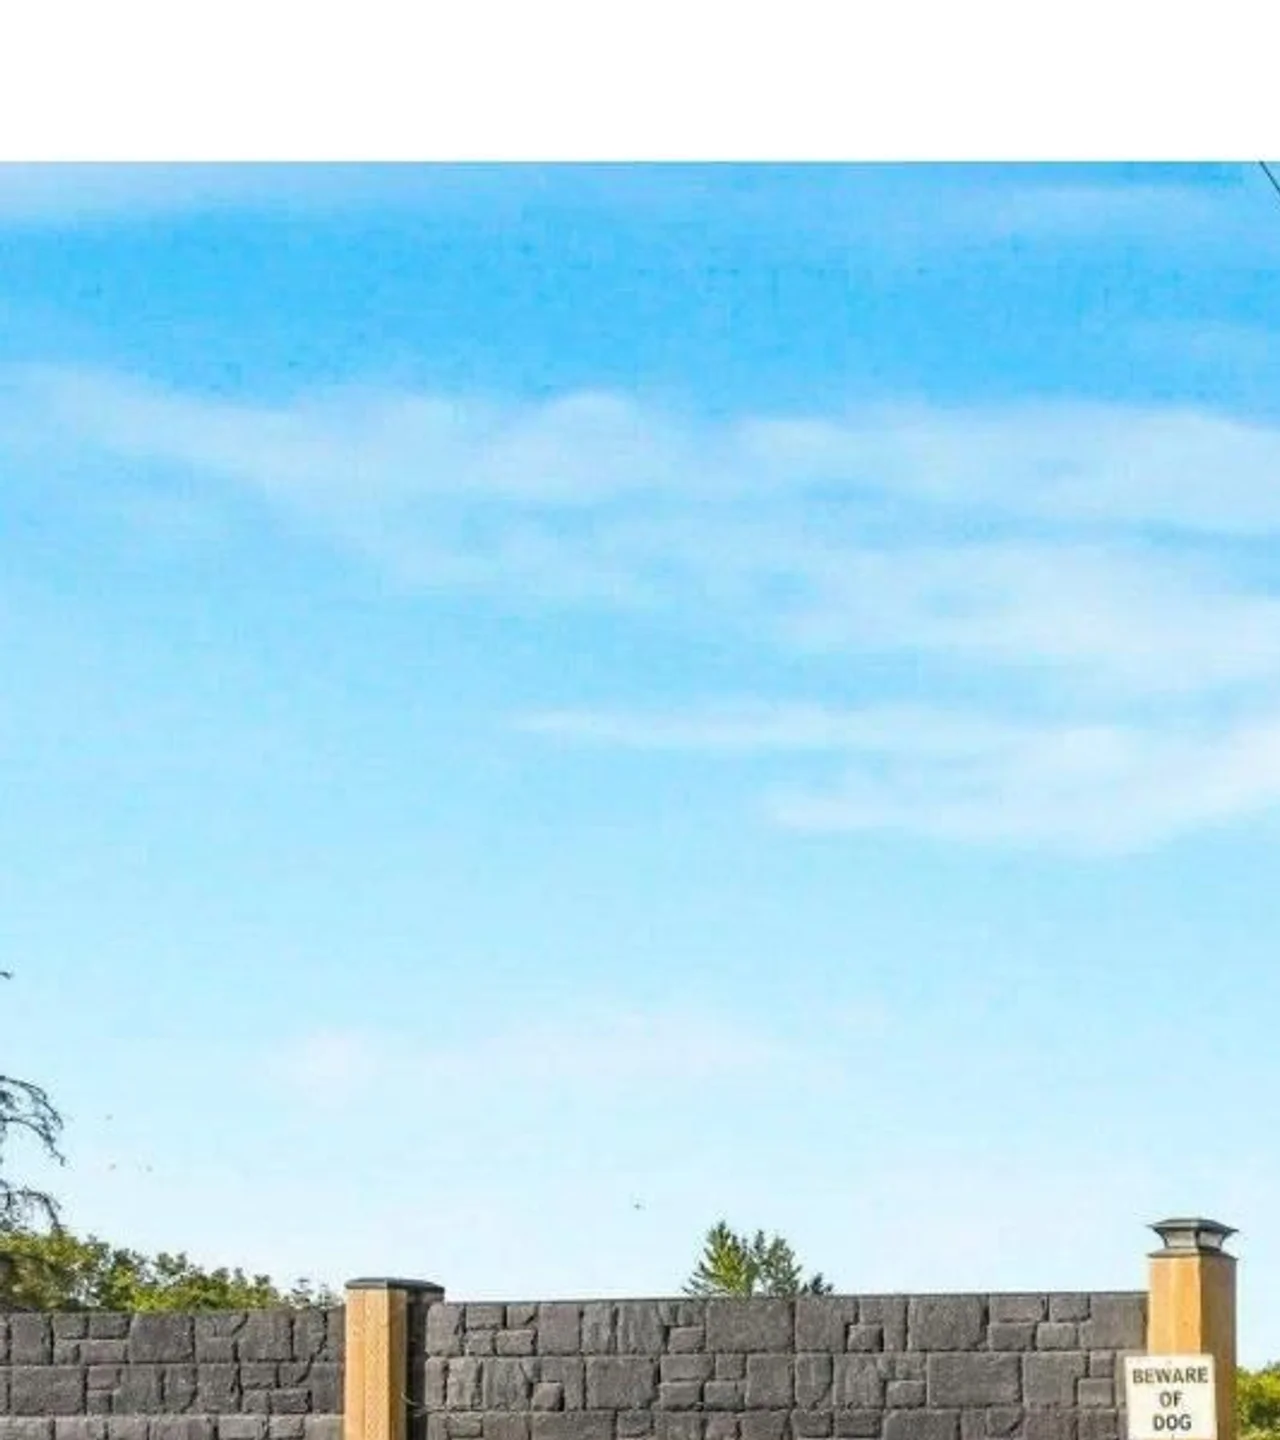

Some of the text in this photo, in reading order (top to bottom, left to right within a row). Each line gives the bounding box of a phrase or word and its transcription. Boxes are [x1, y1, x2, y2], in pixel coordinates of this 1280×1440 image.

[1132, 1366, 1208, 1384] BEWARE
[1159, 1390, 1183, 1408] OF
[1153, 1413, 1192, 1431] DOG
